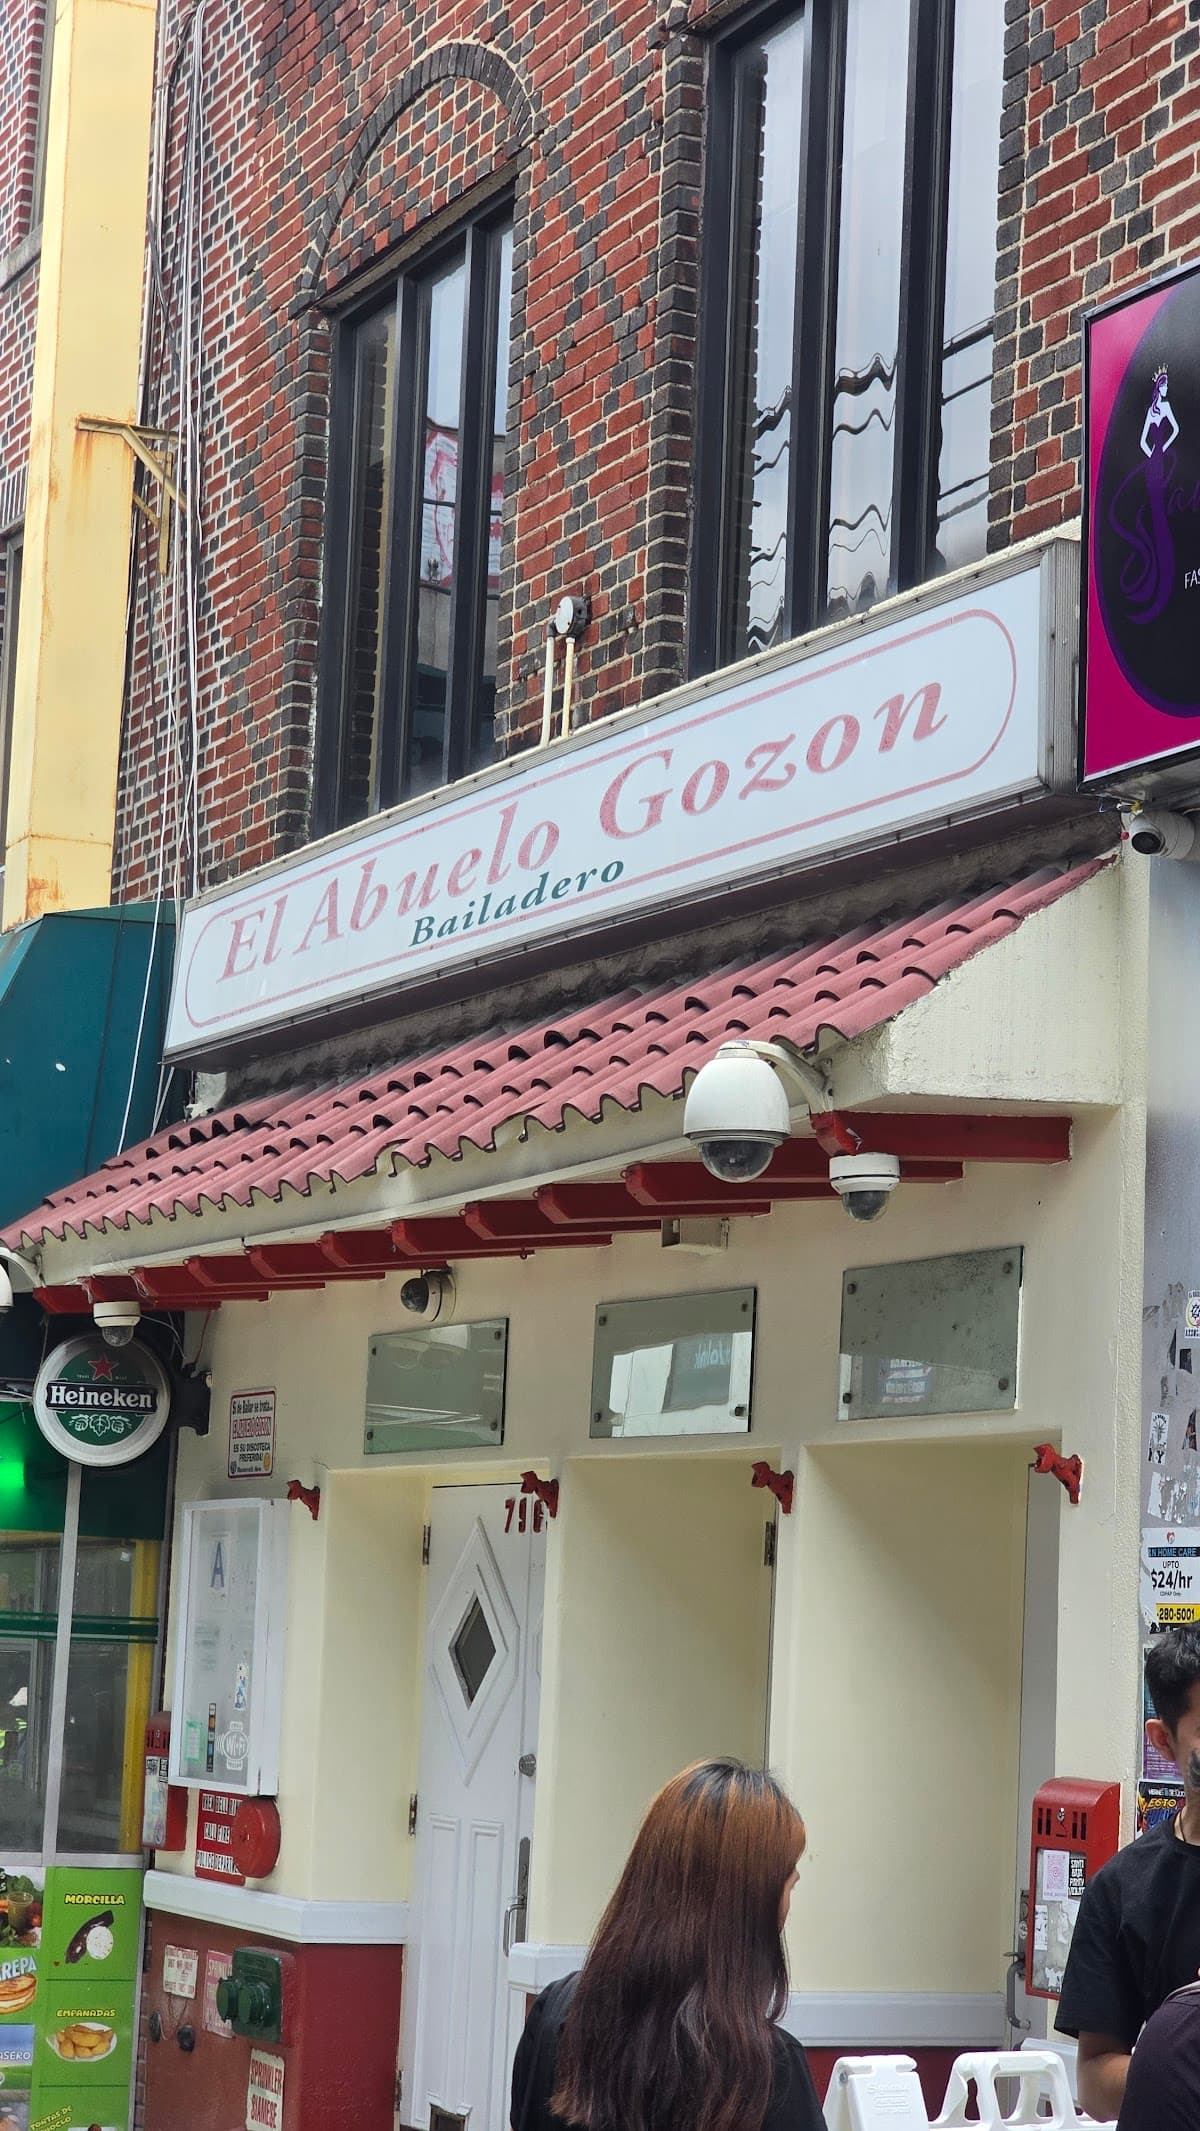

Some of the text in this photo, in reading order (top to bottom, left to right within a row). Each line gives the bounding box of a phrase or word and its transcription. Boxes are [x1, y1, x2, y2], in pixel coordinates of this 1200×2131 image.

[215, 681, 948, 985] El Abuelo Gozon
[409, 860, 624, 948] Bailadero
[50, 1385, 152, 1408] Heineken
[246, 1442, 271, 1452] DISCOTECA
[1157, 1548, 1177, 1557] HOME
[1177, 1548, 1197, 1557] CARE
[210, 1541, 225, 1588] A
[1150, 1568, 1193, 1590] $24/hr
[64, 1894, 125, 1905] MORCILLA
[56, 2008, 117, 2017] EMPANADAS
[250, 2058, 283, 2096] SPRINKLER
[30, 2110, 61, 2130] TORTAS
